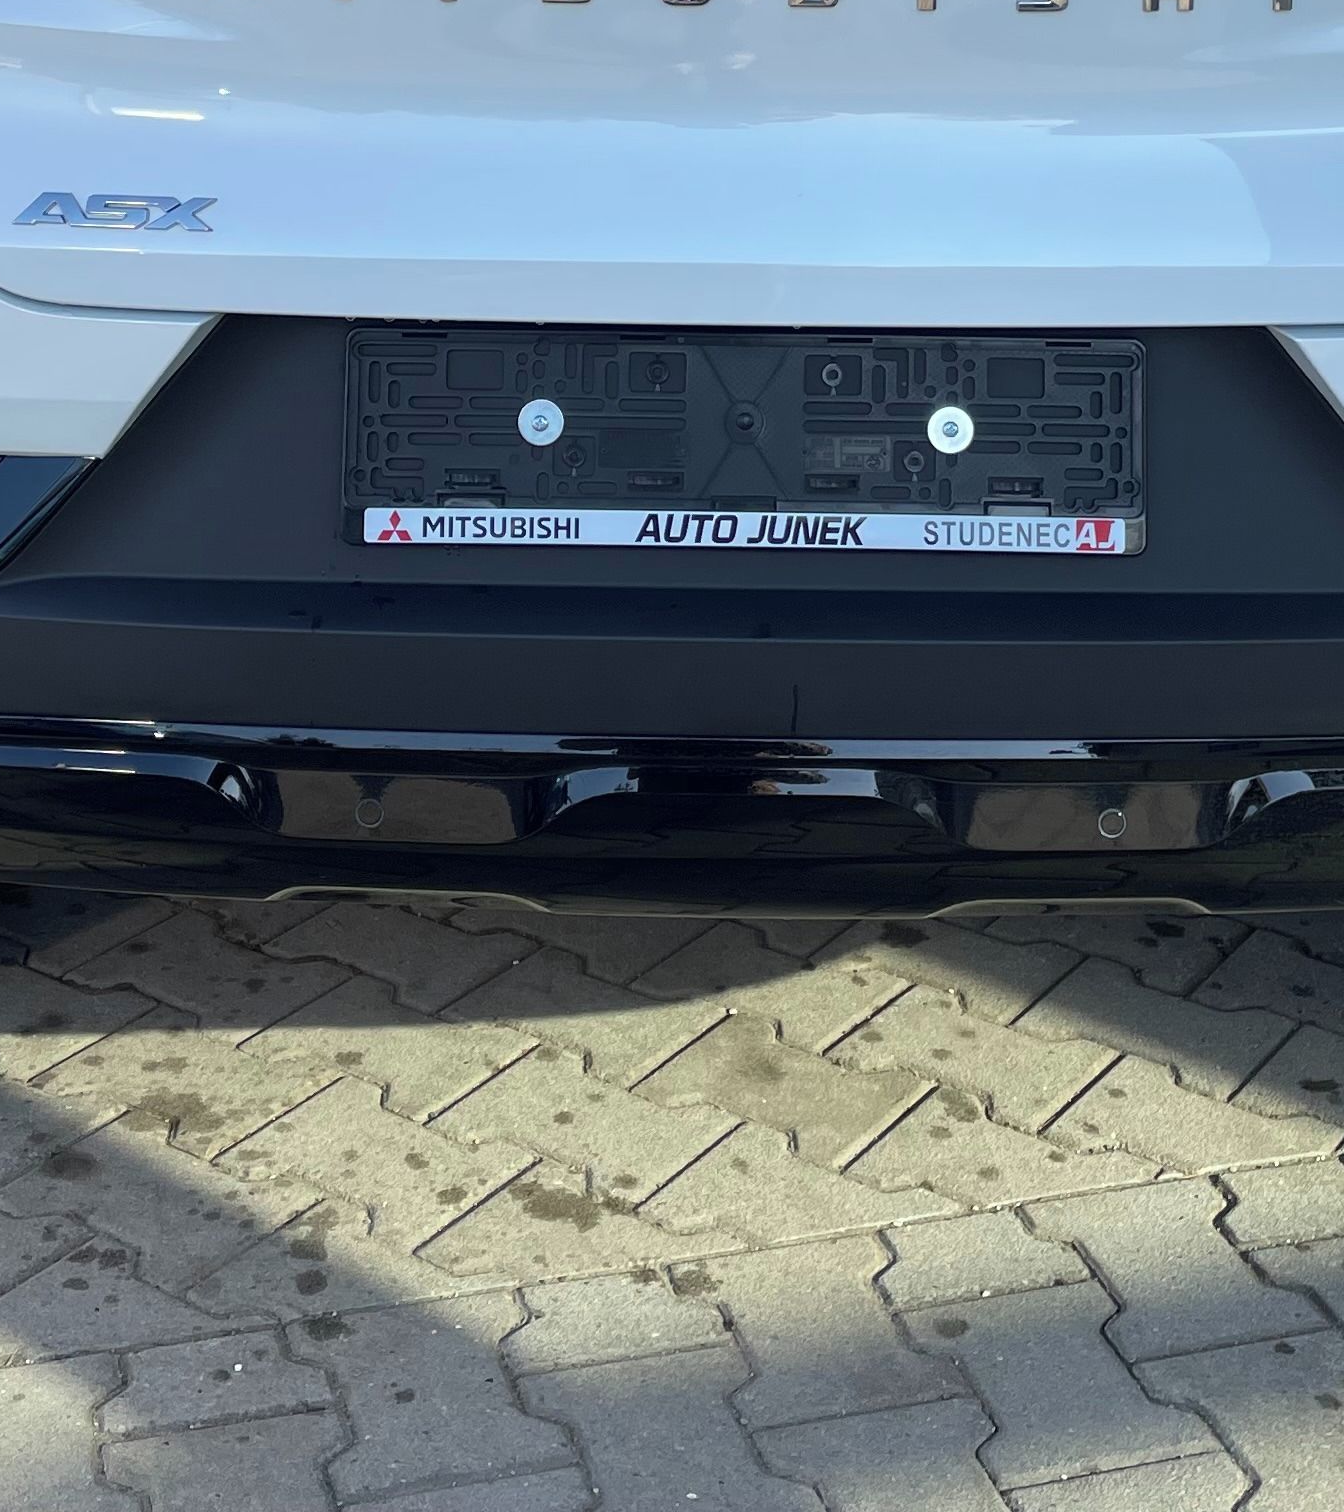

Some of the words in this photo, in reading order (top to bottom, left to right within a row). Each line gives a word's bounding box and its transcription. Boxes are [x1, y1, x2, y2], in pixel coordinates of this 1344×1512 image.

[12, 191, 219, 232] ASX
[422, 515, 580, 540] MITSUBISHI
[635, 513, 739, 544] AUTO
[746, 514, 868, 547] JUNEK
[923, 520, 1071, 548] STUDENEC
